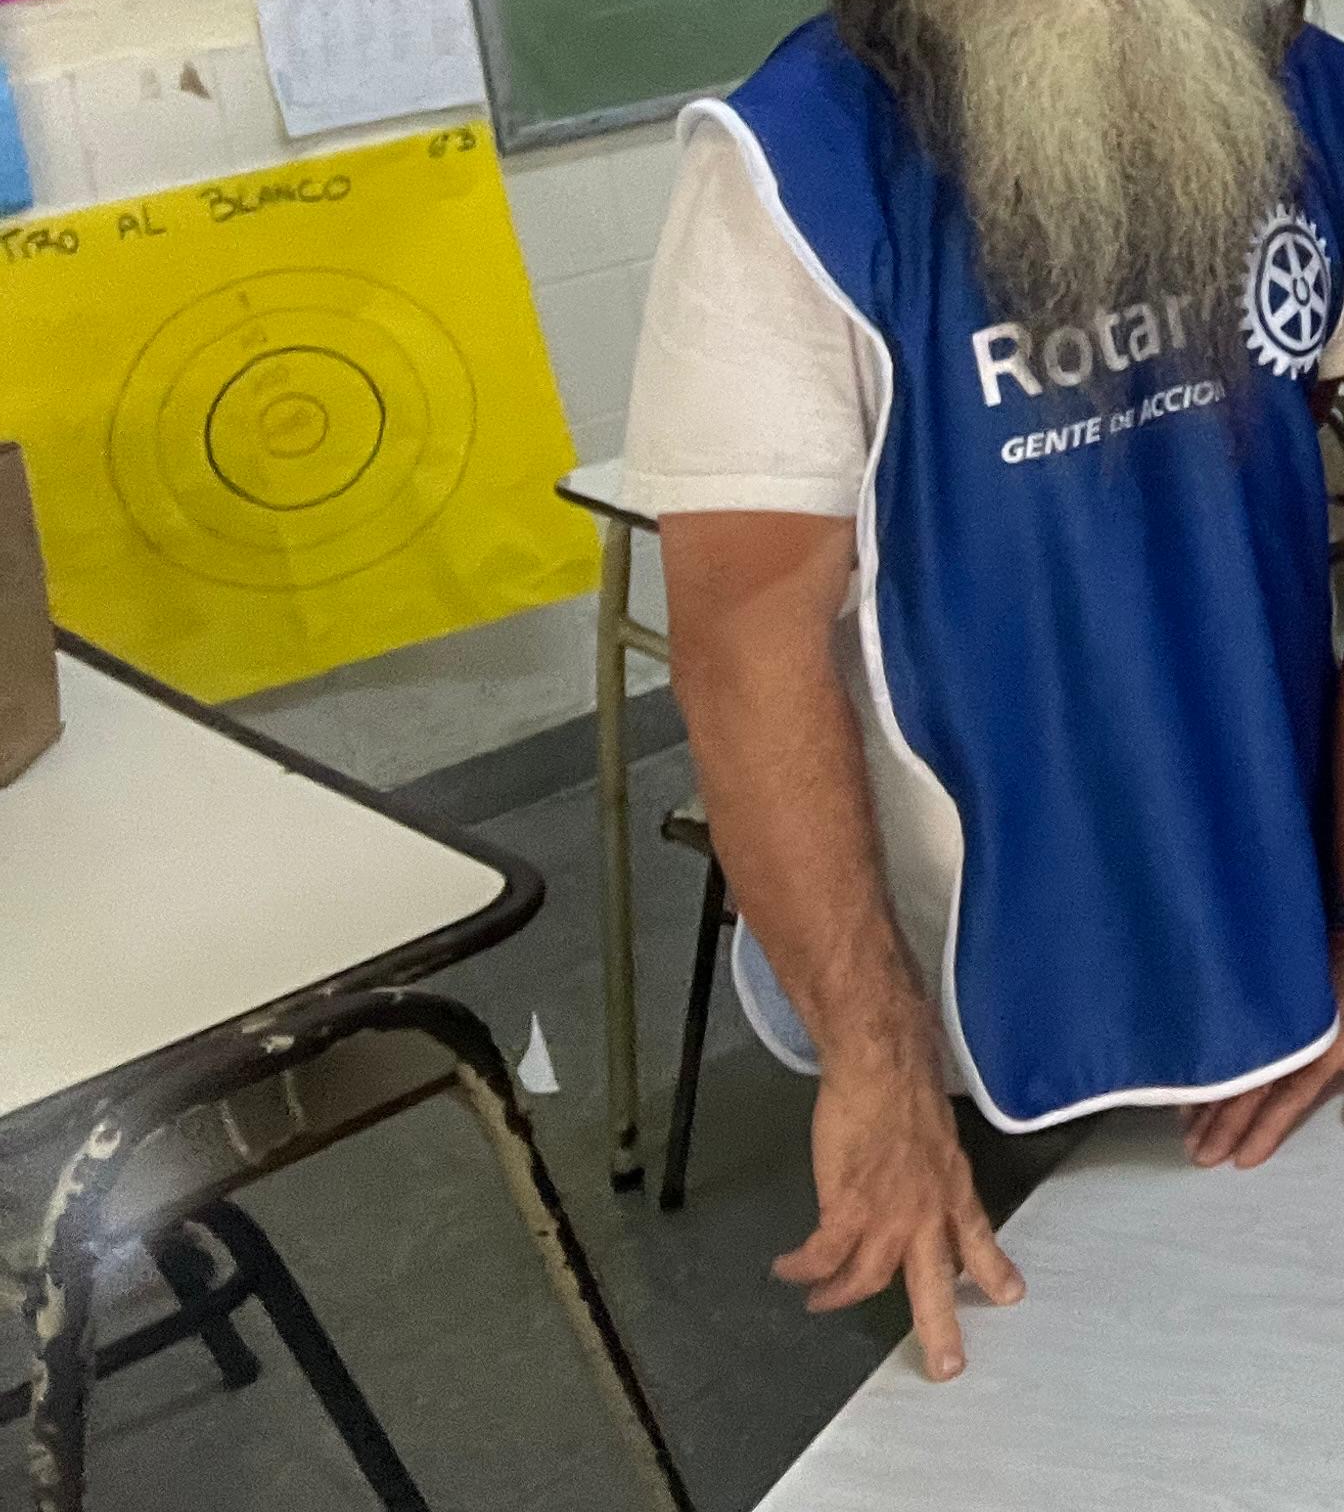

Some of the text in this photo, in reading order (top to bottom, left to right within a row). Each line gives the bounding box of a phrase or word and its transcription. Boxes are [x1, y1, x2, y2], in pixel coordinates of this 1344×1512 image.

[117, 205, 168, 241] AL
[199, 173, 353, 224] BLANCO
[972, 292, 1190, 408] Rotar
[1001, 416, 1102, 464] GENTE
[1109, 409, 1136, 435] DE
